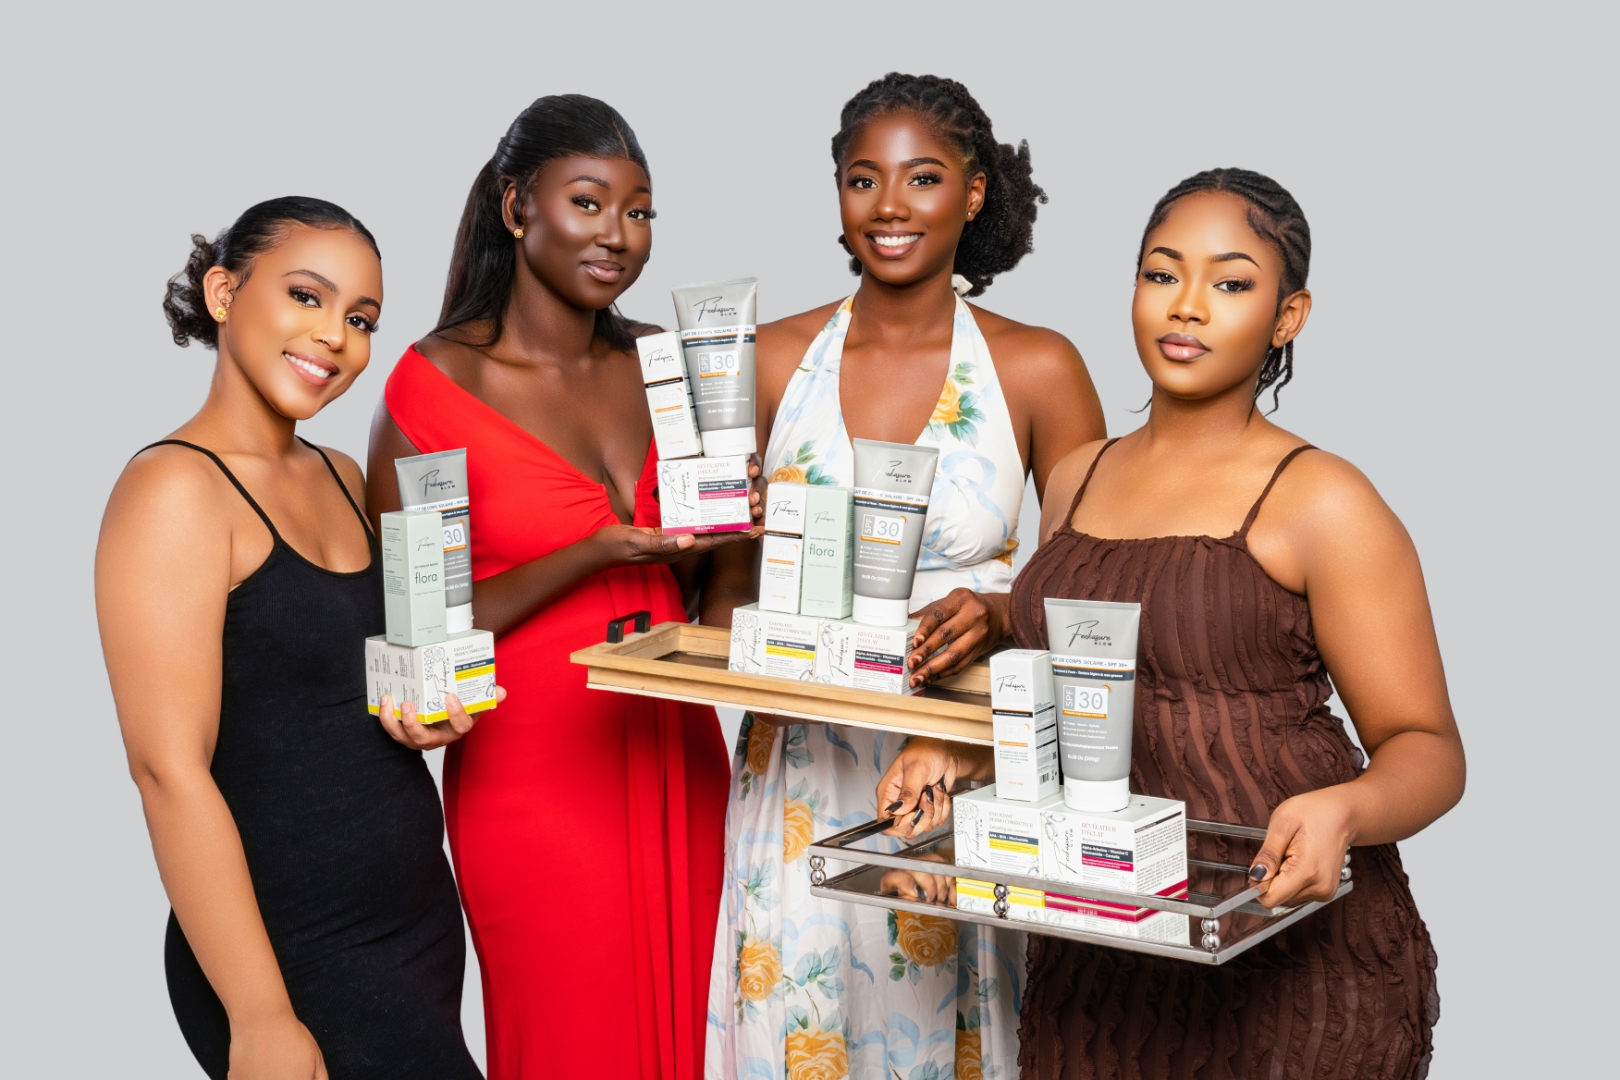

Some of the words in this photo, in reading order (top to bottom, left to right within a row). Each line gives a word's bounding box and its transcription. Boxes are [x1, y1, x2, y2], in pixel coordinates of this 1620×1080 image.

[714, 354, 735, 370] 30
[444, 528, 462, 544] 30
[877, 520, 900, 537] 30
[810, 544, 834, 558] flora
[415, 572, 438, 584] flora
[1078, 691, 1103, 710] 30
